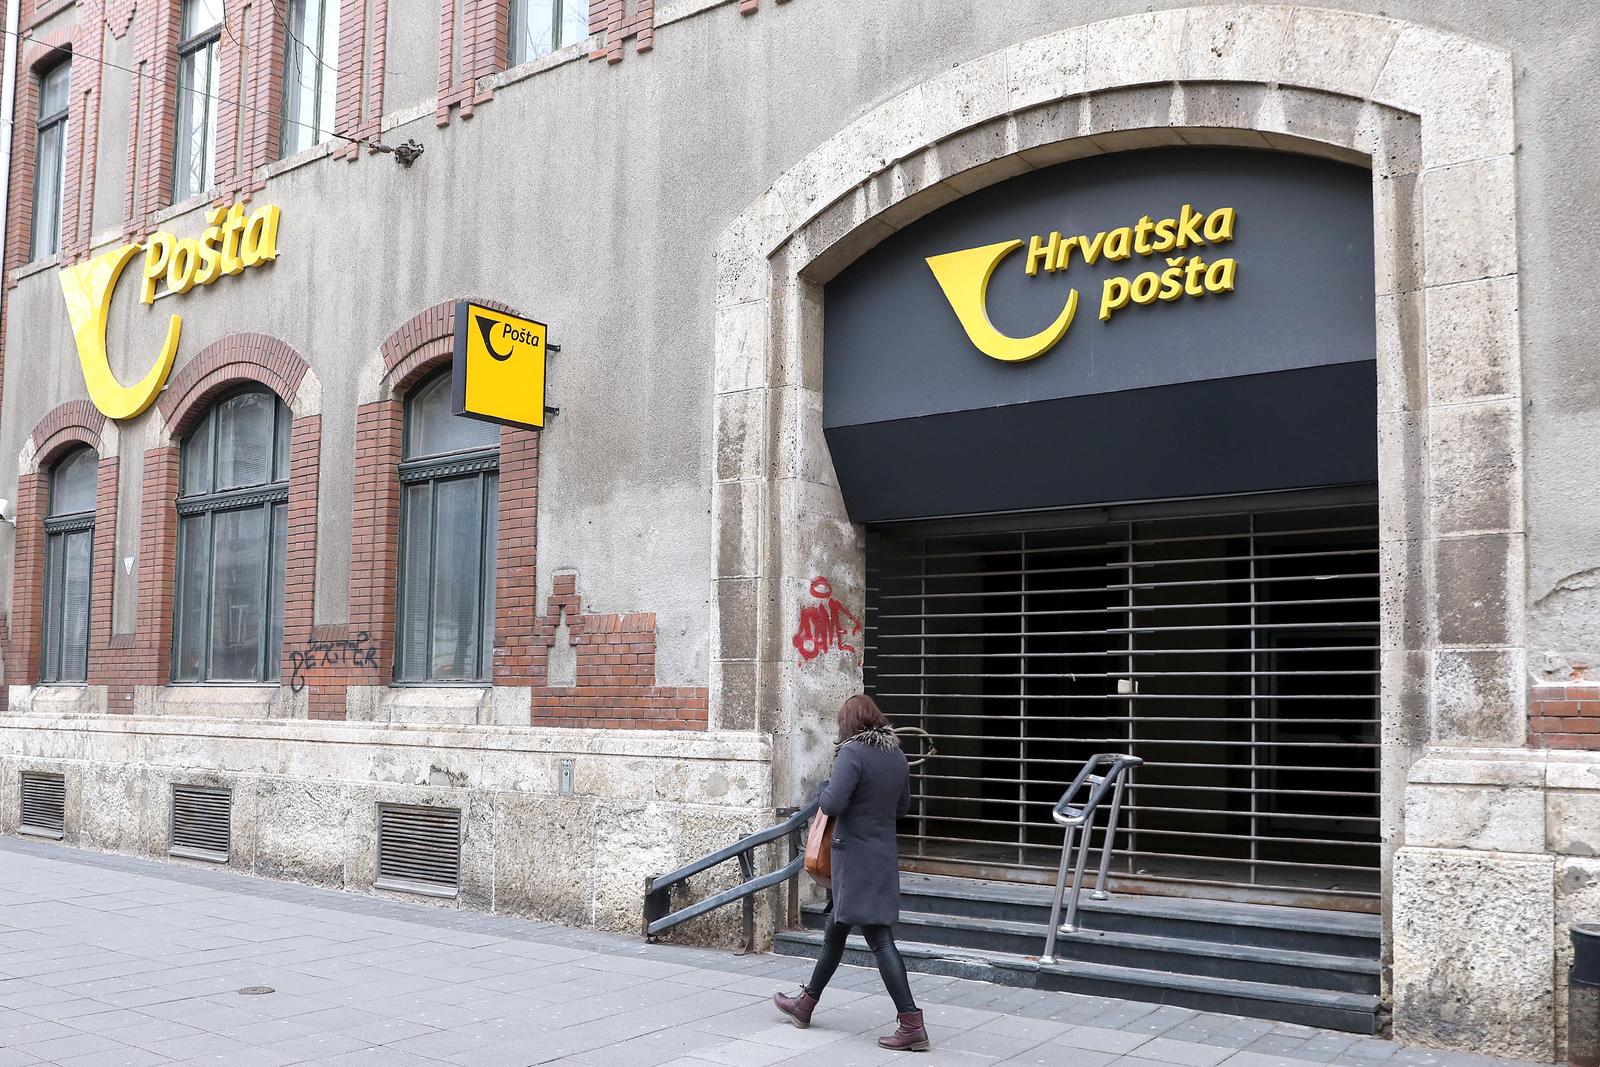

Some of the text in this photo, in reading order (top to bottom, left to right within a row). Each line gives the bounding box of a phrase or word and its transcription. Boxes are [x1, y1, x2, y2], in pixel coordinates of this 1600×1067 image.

[139, 201, 281, 304] Pošta
[1024, 204, 1236, 276] Hrvatska
[1098, 256, 1237, 321] pošta
[502, 323, 540, 347] Pošta
